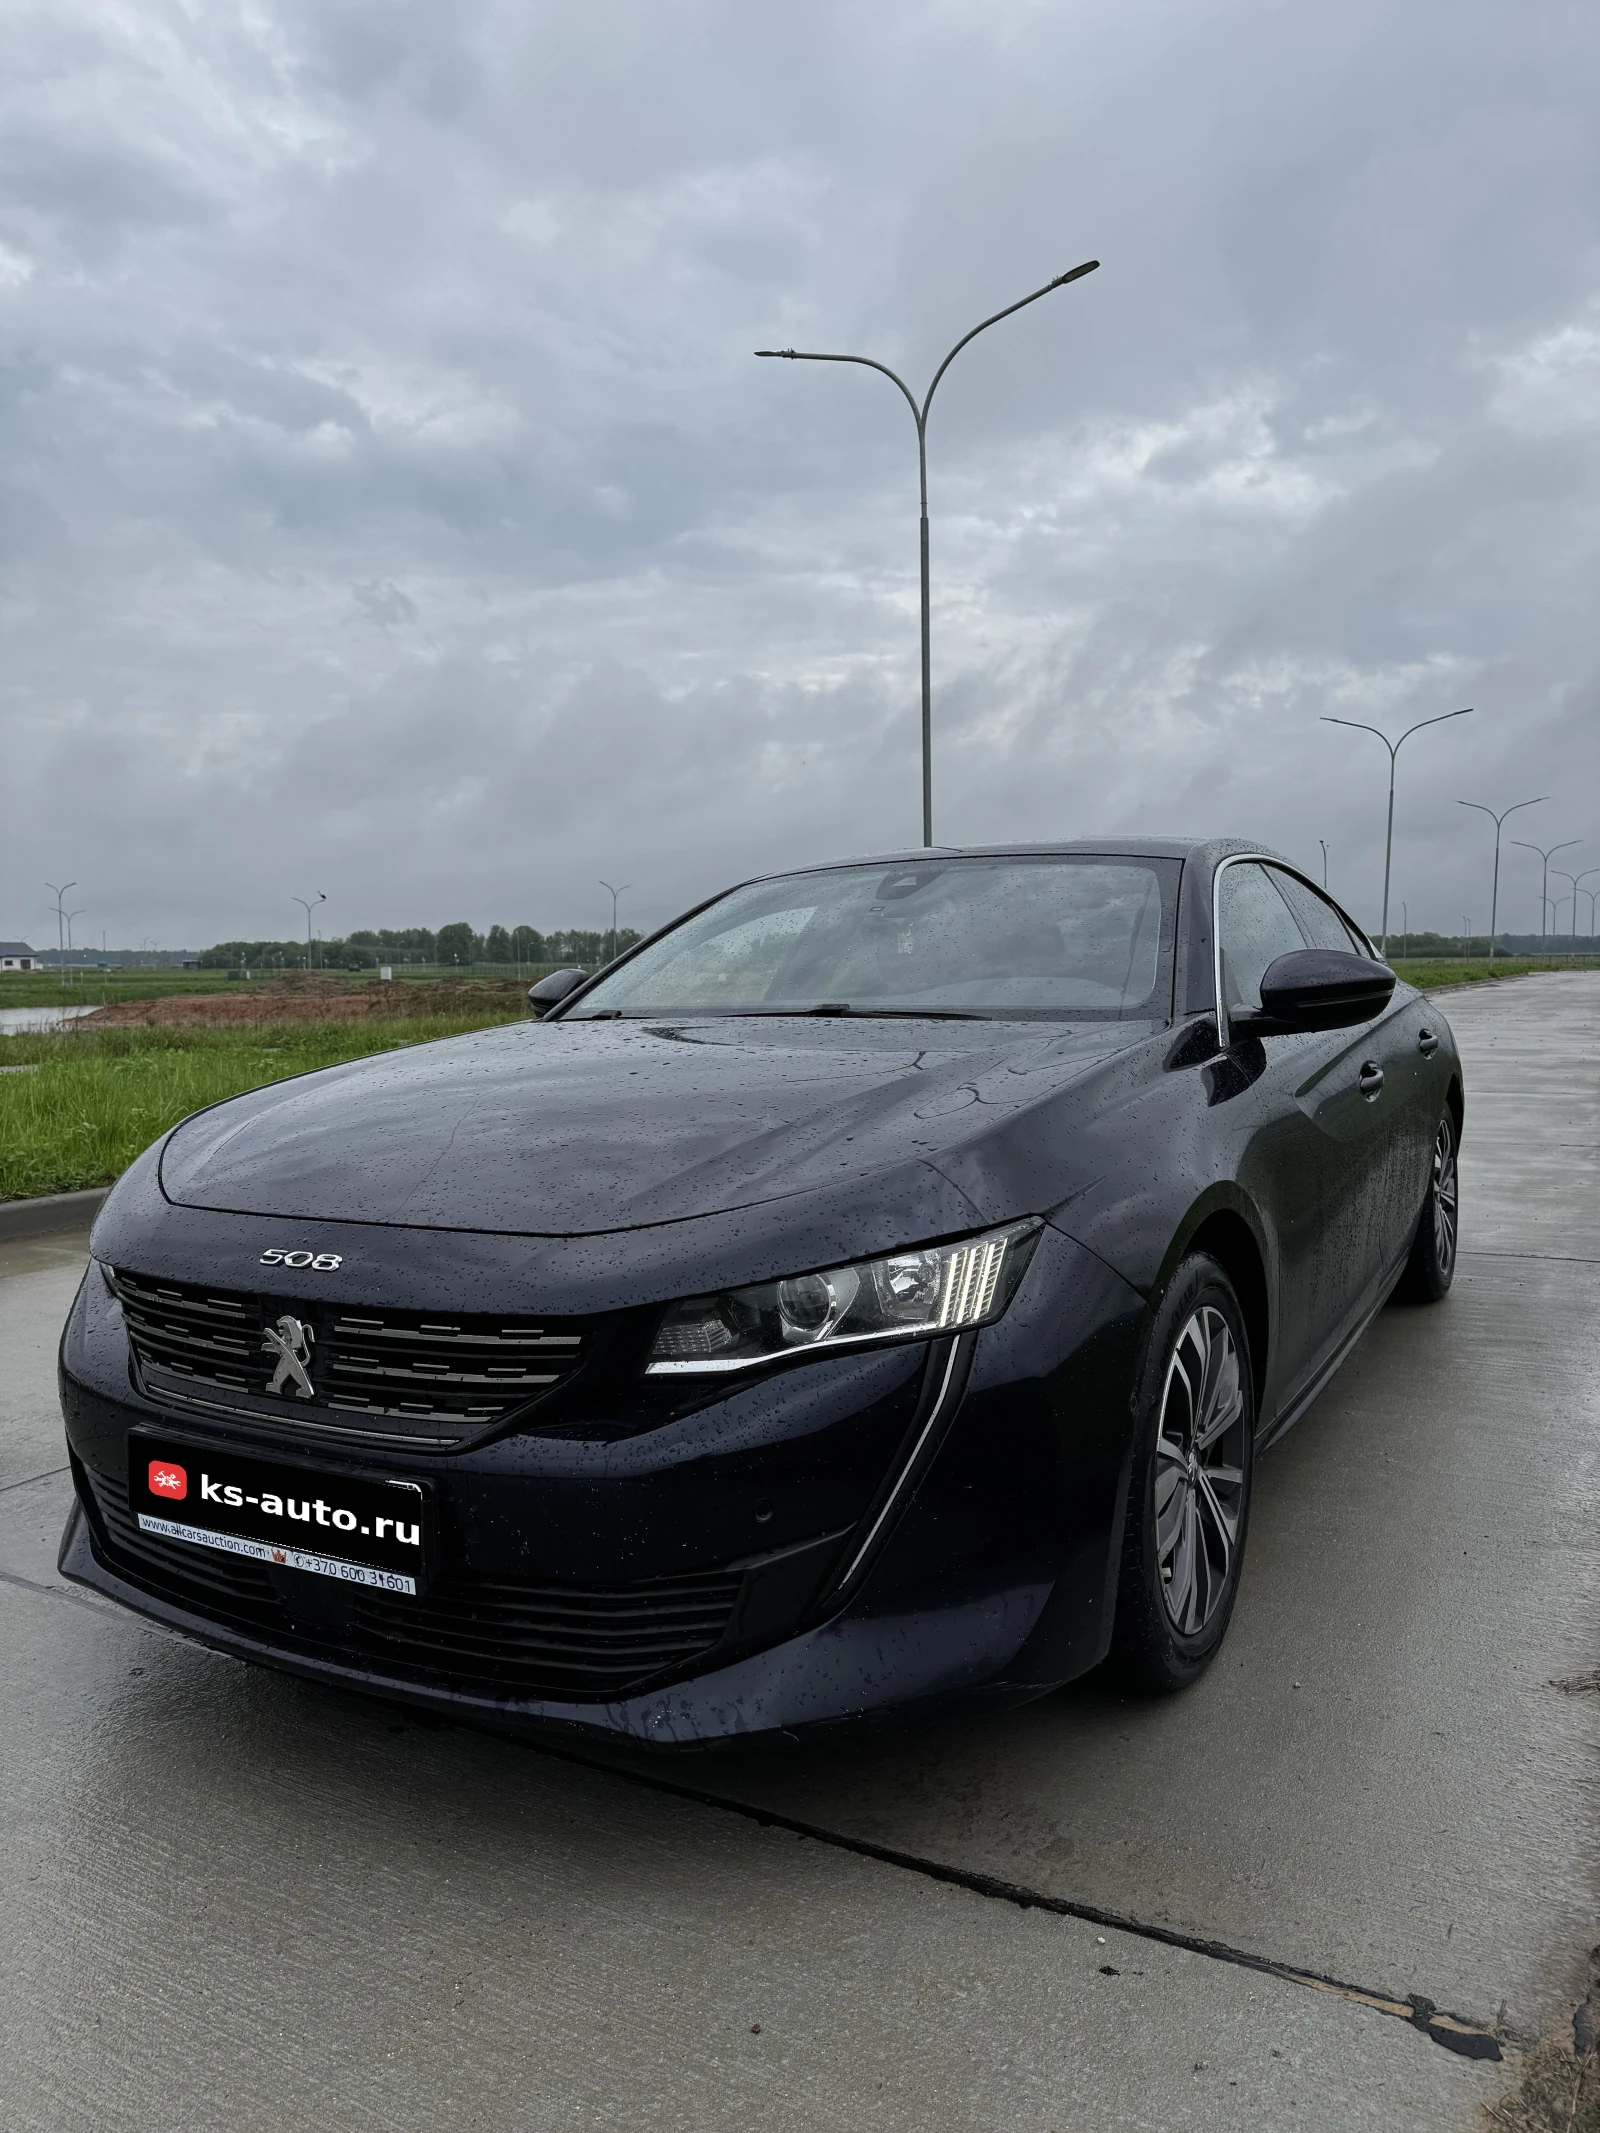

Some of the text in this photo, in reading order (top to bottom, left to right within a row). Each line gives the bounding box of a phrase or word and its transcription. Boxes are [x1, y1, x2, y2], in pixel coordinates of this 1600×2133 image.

[259, 1249, 342, 1271] 508
[142, 1517, 266, 1558] www.allcarsauction.com
[305, 1558, 337, 1575] +370
[340, 1565, 365, 1582] 600
